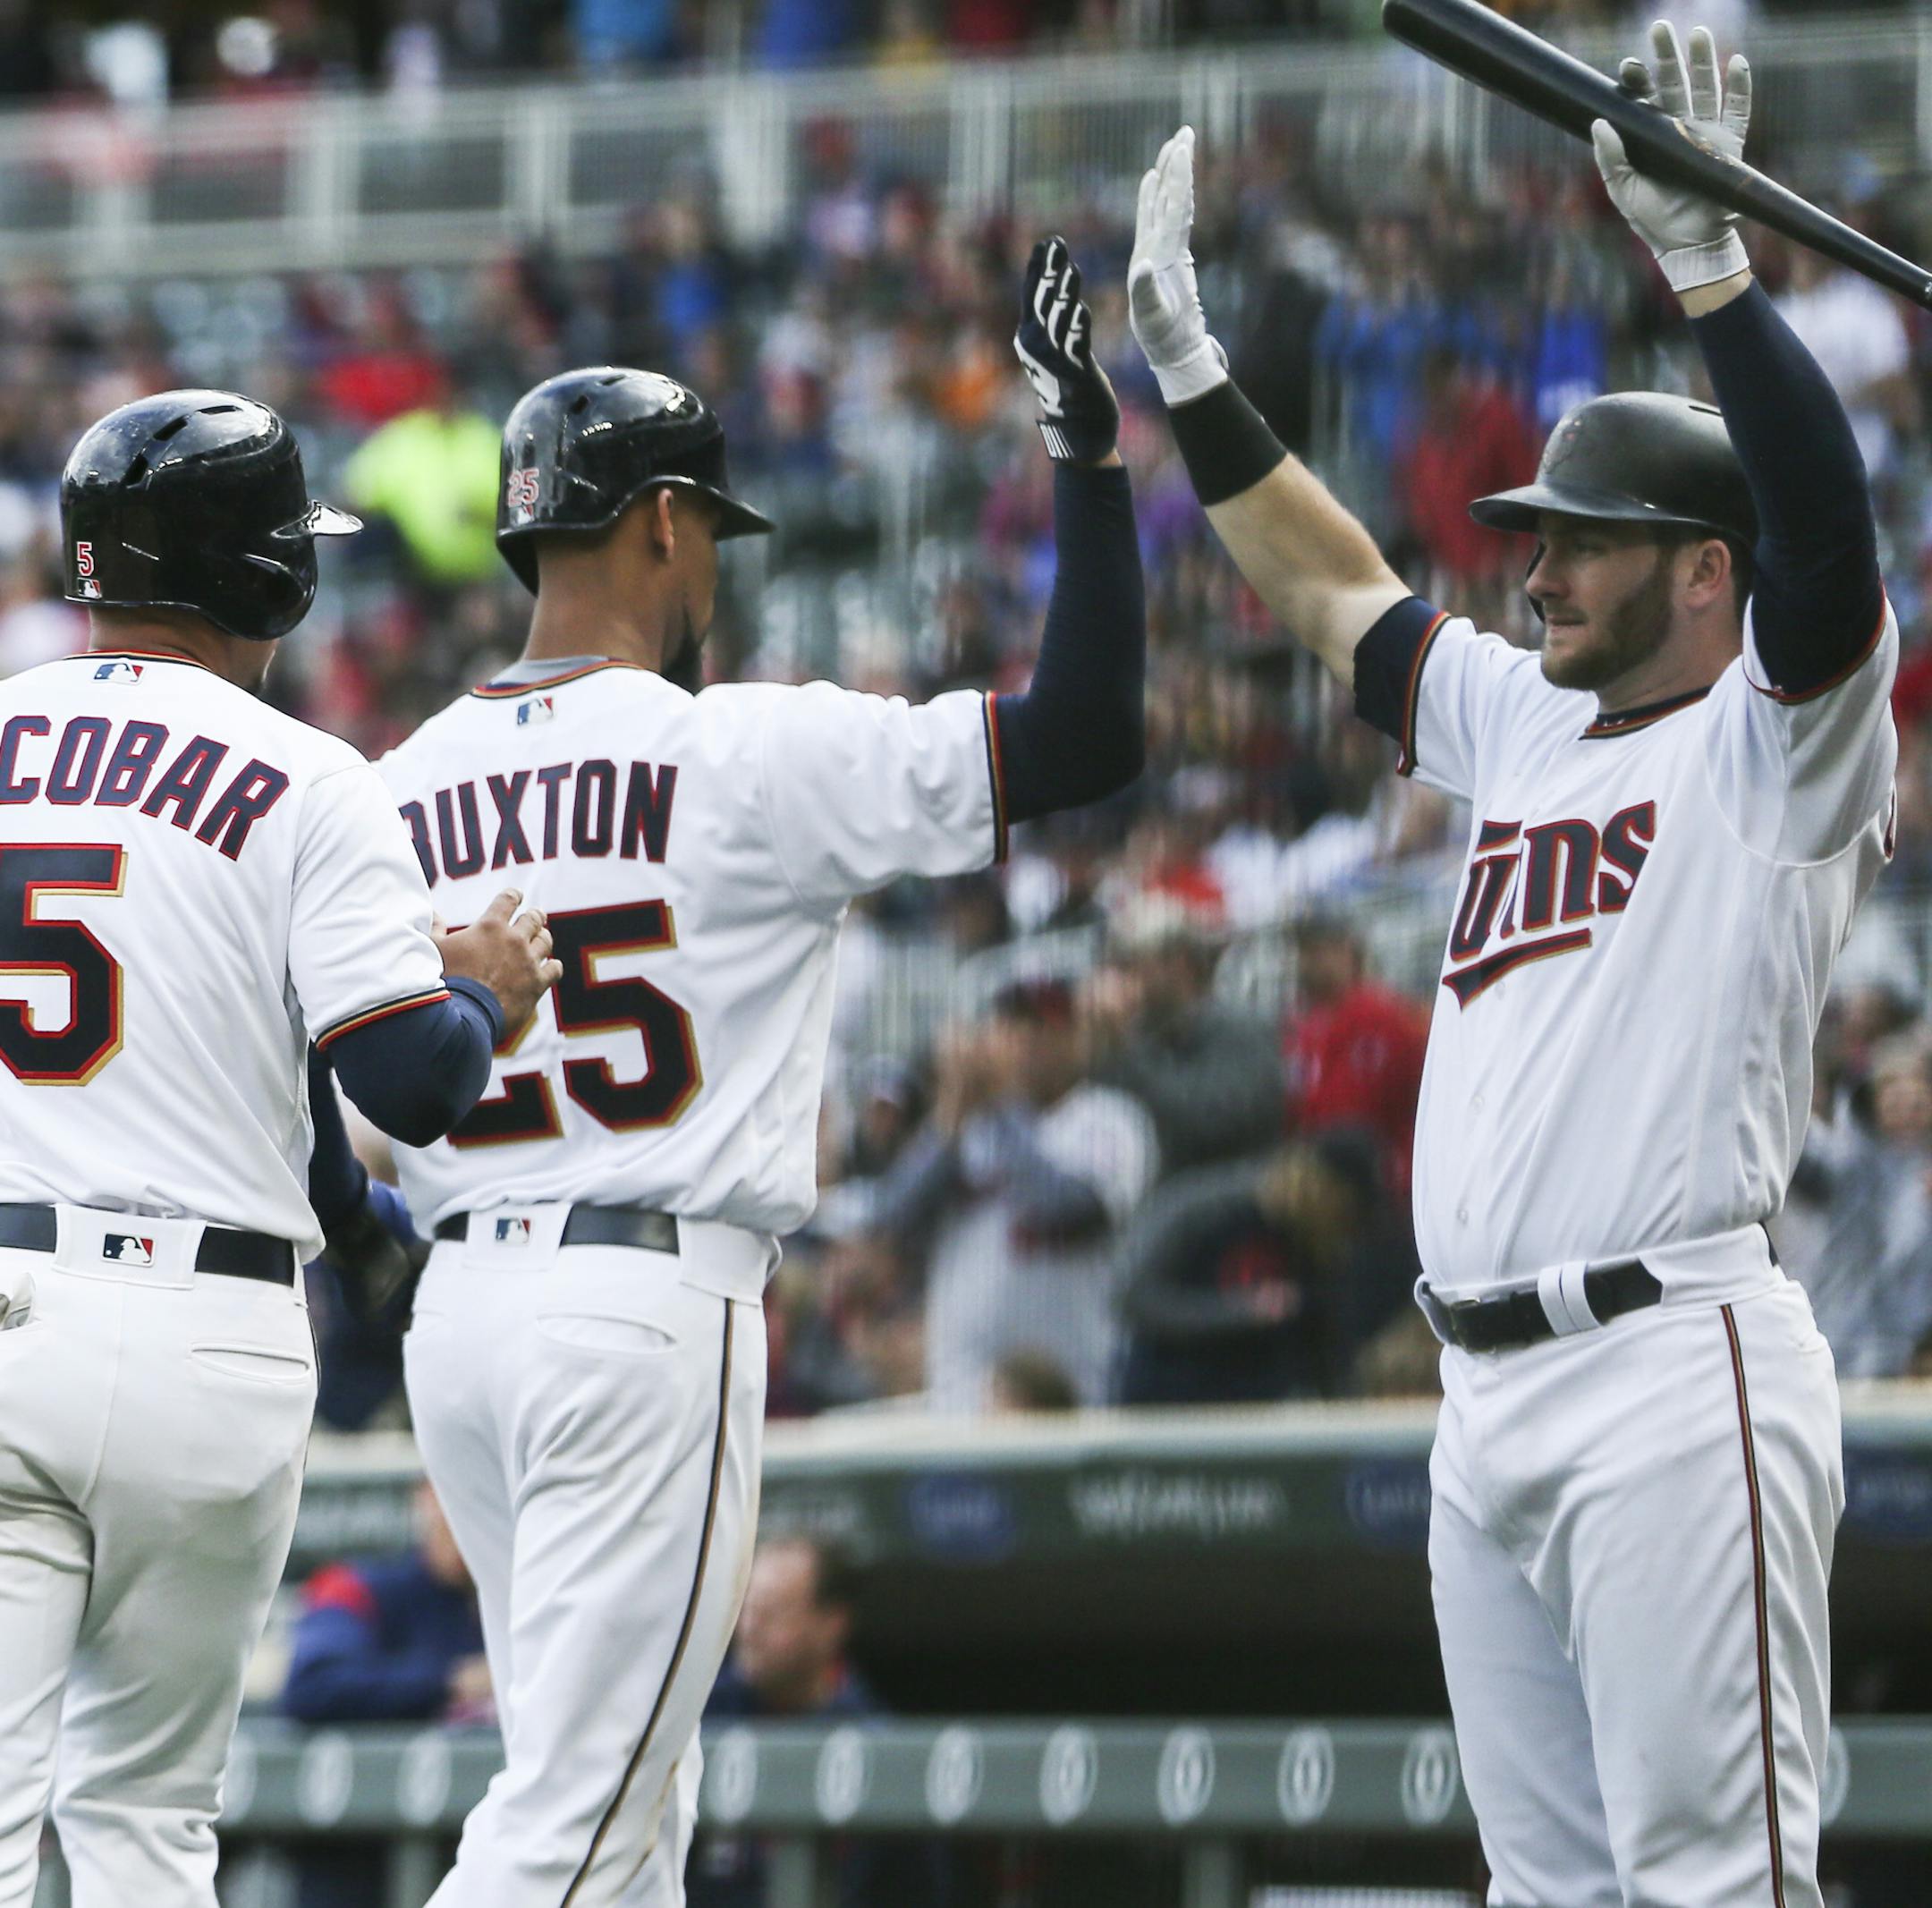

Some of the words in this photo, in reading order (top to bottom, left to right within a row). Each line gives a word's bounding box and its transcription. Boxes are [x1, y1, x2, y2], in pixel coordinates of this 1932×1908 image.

[508, 468, 540, 508] 25
[76, 541, 95, 577] 5
[0, 715, 291, 861] COBAR
[0, 843, 129, 1087] 5
